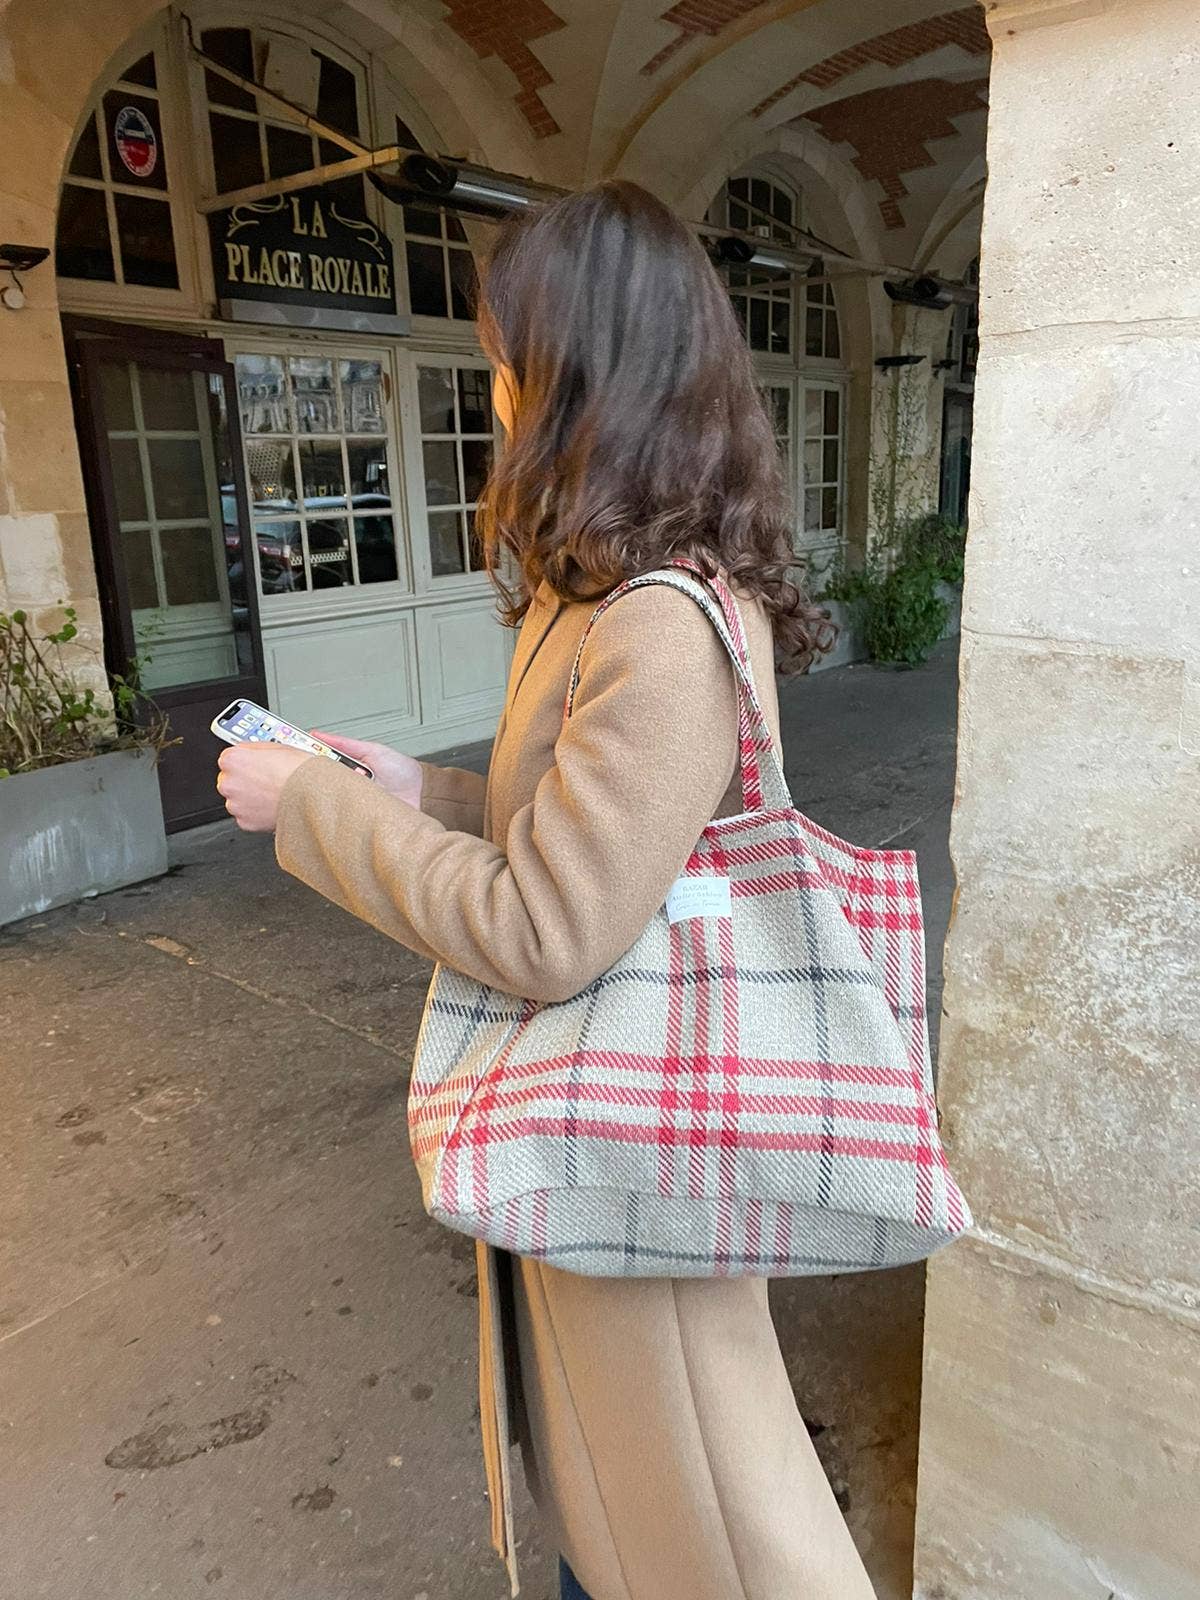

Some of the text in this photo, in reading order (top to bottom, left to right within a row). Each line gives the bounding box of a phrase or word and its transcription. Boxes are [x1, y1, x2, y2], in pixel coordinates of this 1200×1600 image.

[290, 196, 328, 239] LA
[224, 242, 391, 299] PLACE ROYALE
